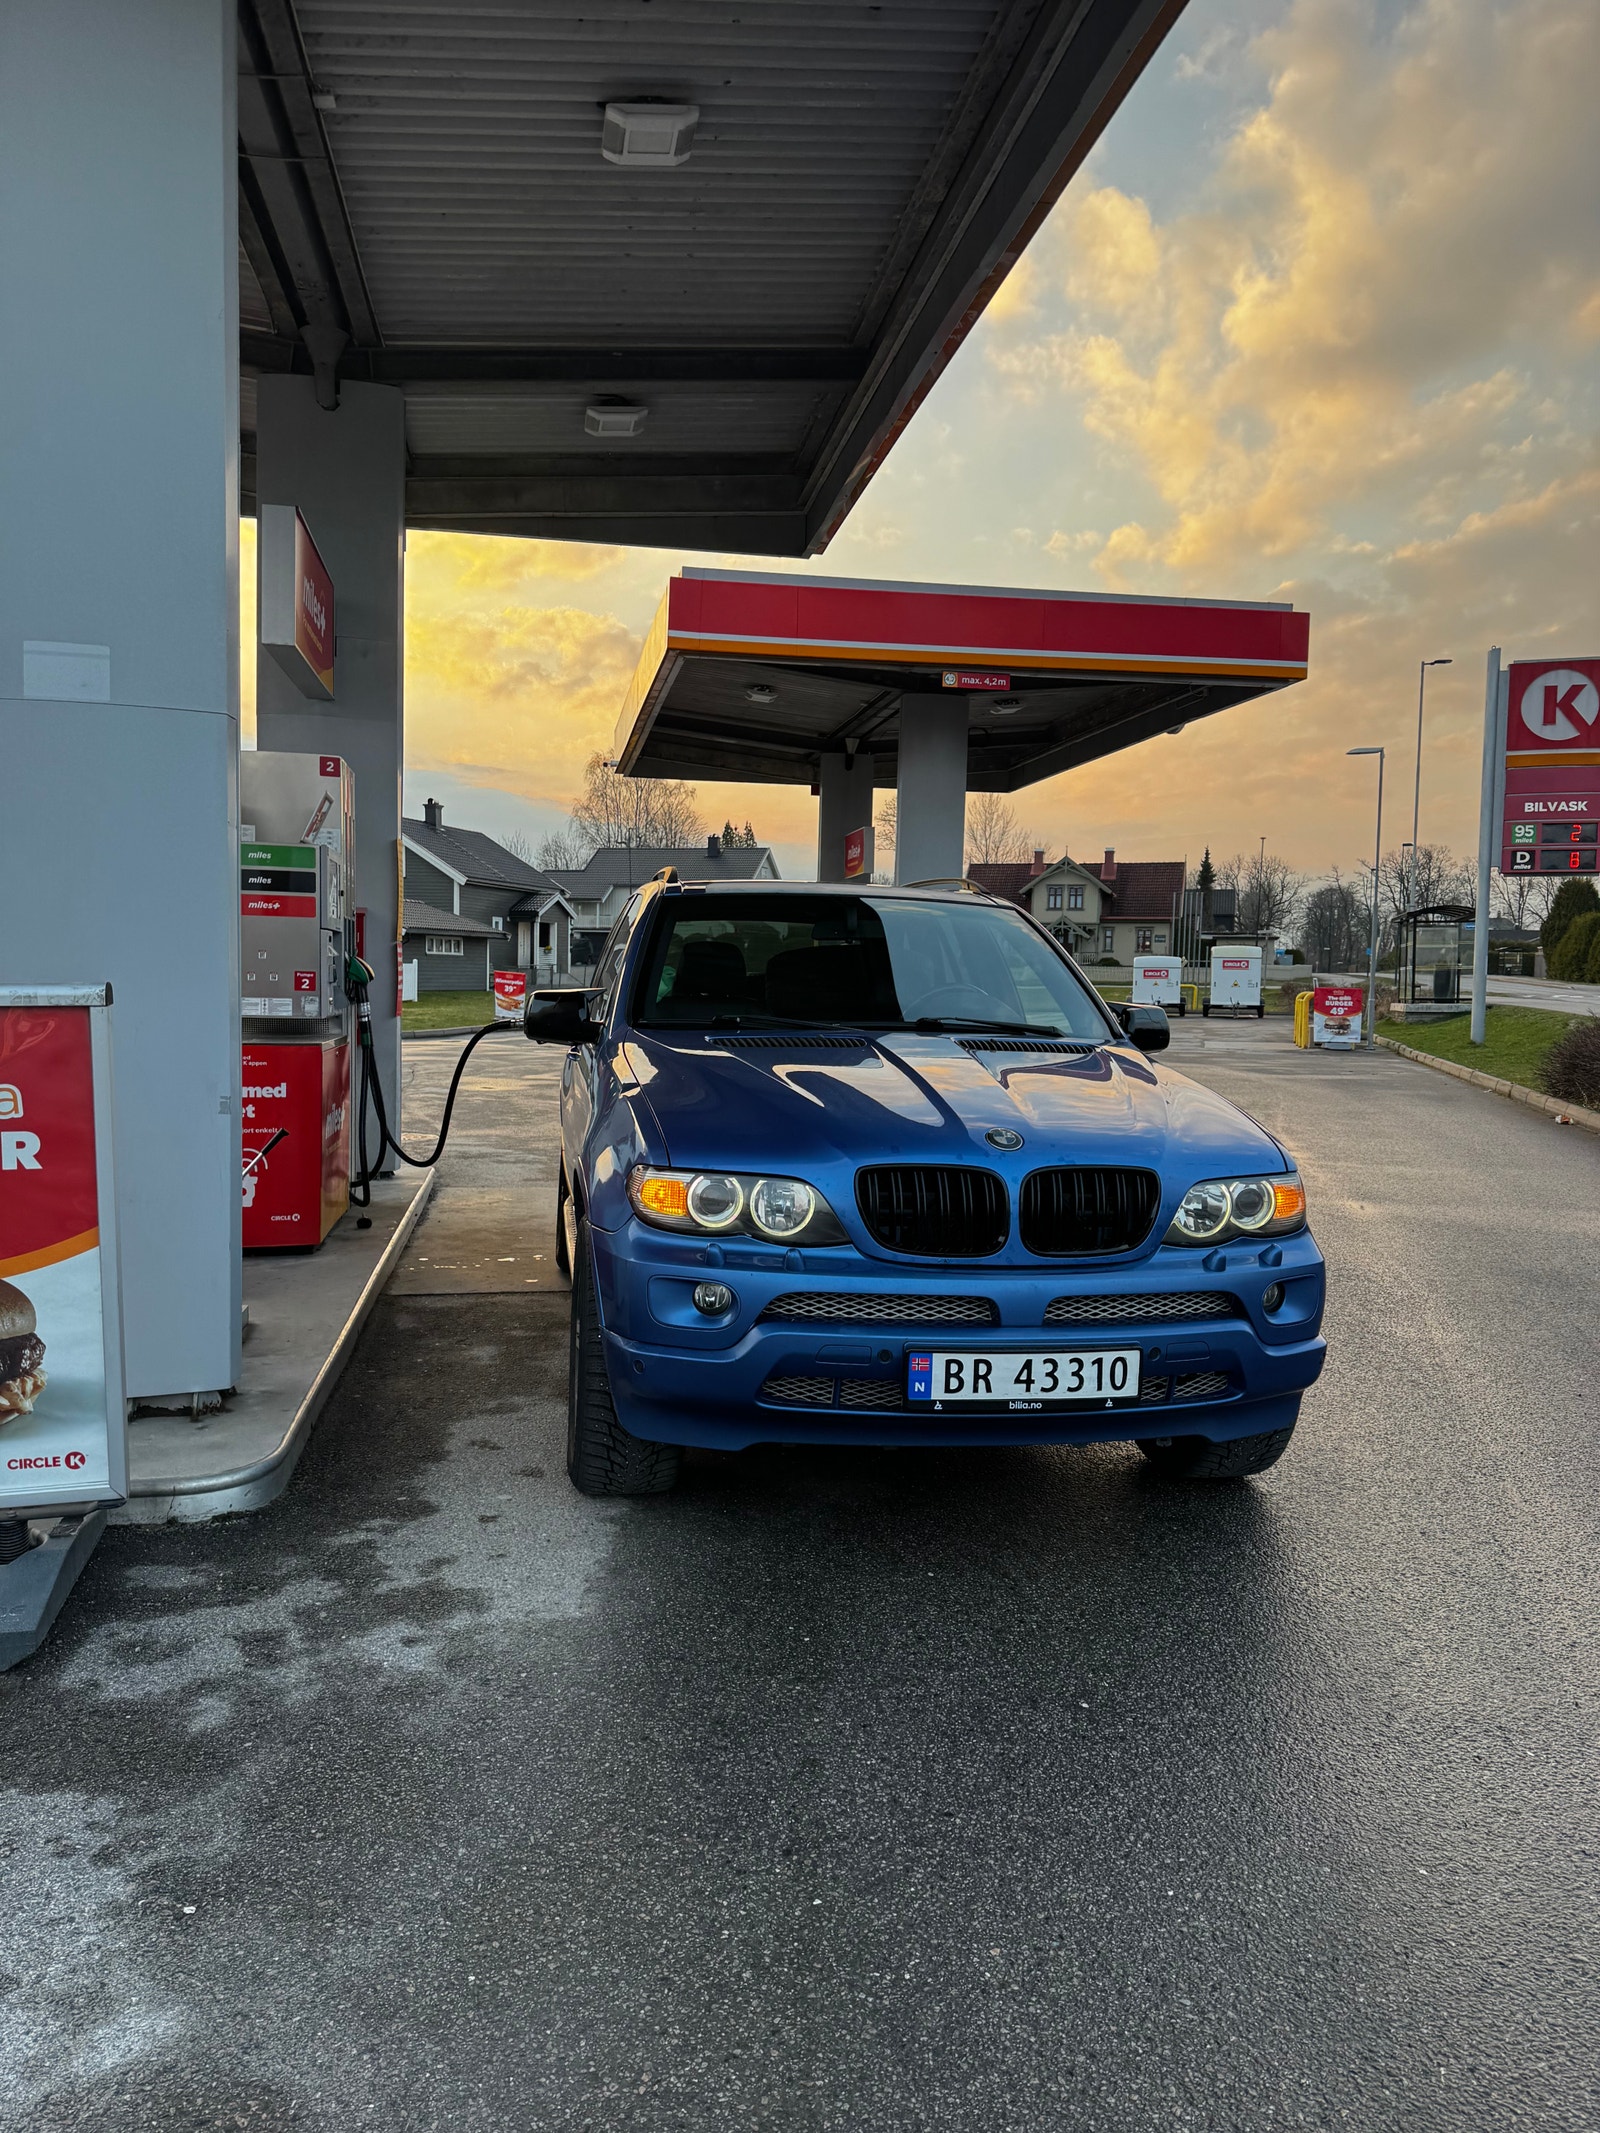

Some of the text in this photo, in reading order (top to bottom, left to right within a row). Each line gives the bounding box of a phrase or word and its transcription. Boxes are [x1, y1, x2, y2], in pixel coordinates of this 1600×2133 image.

[961, 676, 982, 685] max.
[326, 761, 334, 772] 2
[1524, 801, 1588, 813] BILVASK
[1515, 825, 1534, 837] 95
[248, 851, 272, 859] miles
[1516, 851, 1531, 864] D
[248, 876, 272, 884] miles
[301, 978, 310, 989] 2
[943, 1355, 1129, 1395] BR 43310
[914, 1381, 925, 1392] N
[1009, 1401, 1043, 1410] bilia.no
[7, 1452, 86, 1470] CIRCLE K
